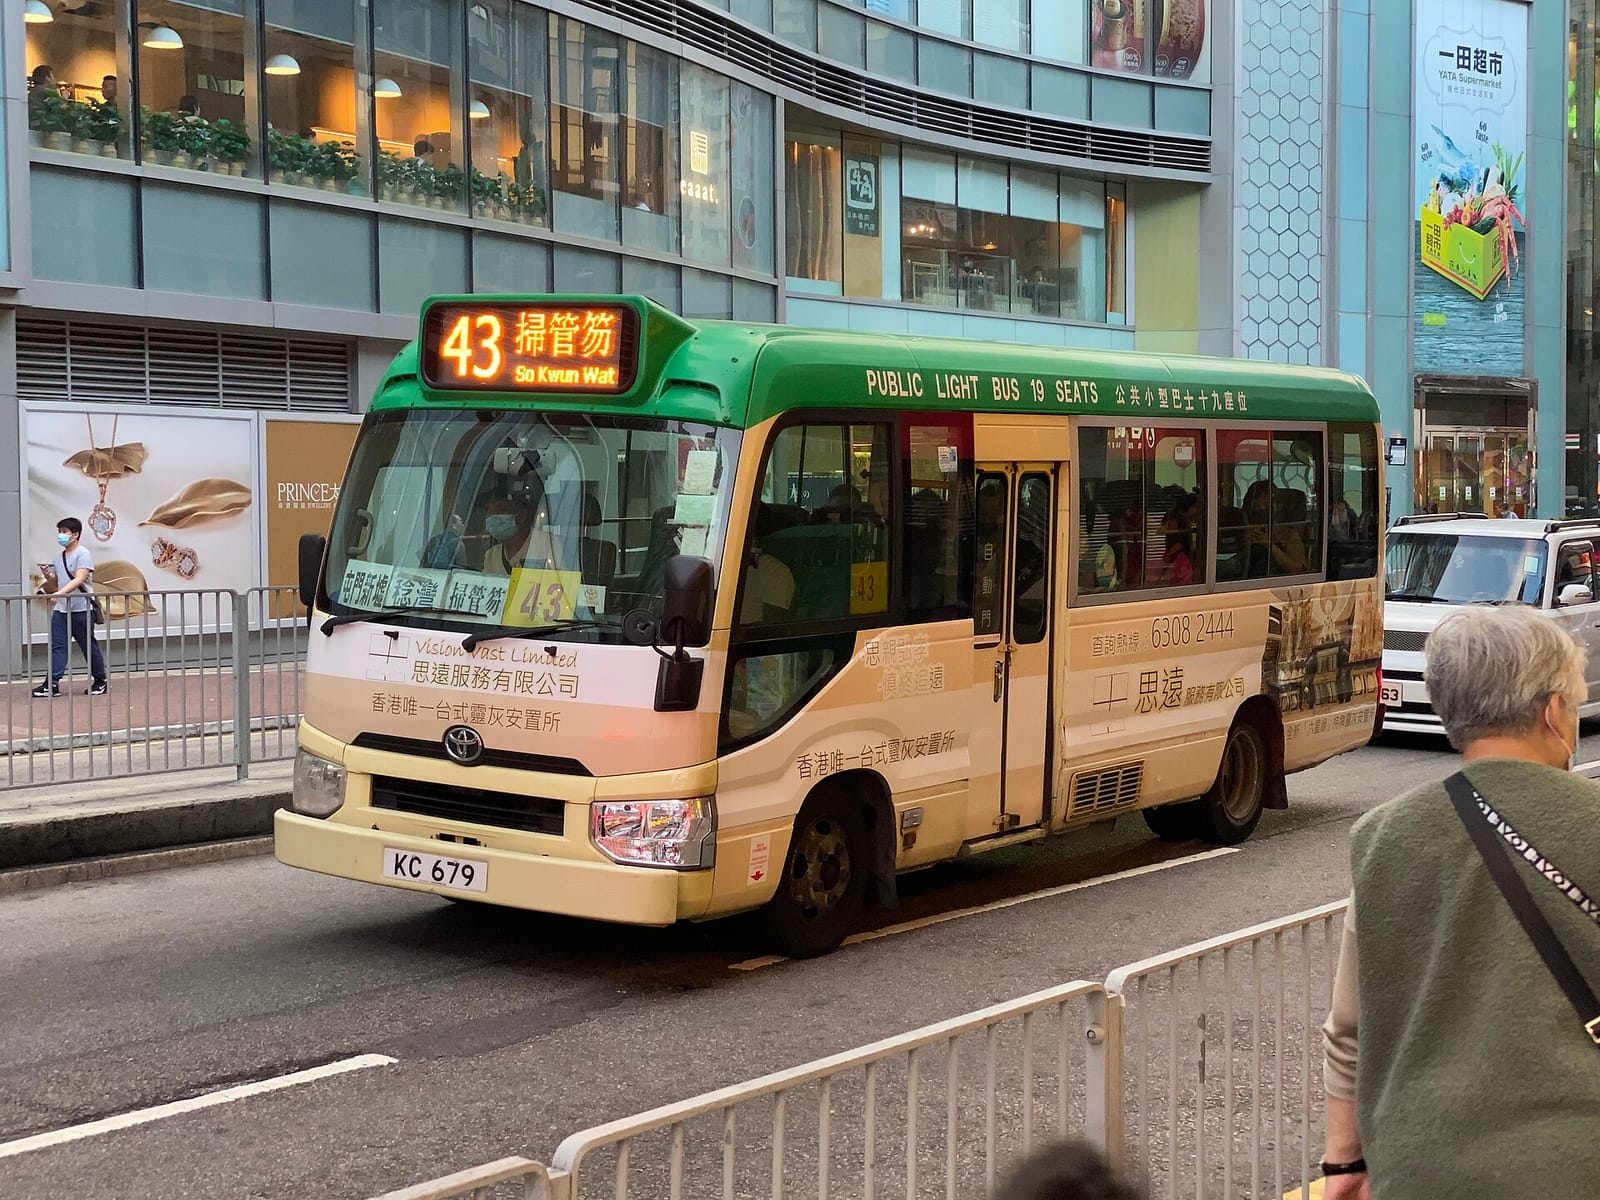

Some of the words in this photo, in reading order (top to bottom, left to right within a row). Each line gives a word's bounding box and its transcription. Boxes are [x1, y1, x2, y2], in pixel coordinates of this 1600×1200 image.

[1438, 45, 1503, 77] 一田超市
[1438, 69, 1457, 82] YATA
[1458, 73, 1502, 90] Supermarket
[1475, 130, 1489, 144] Taste
[441, 314, 501, 379] 43
[515, 311, 615, 357] 掃管笏
[515, 365, 535, 383] So
[537, 366, 579, 384] Kwun
[582, 366, 616, 385] Wat
[866, 369, 923, 397] PUBLIC
[935, 373, 979, 400] LIGHT
[991, 376, 1020, 401] BUS
[1030, 379, 1045, 402] 19
[1055, 379, 1098, 404] SEATS
[1115, 384, 1248, 412] 公共小型巴士十九座位
[277, 482, 330, 502] PRINCE
[450, 581, 506, 616] 掃管笏
[520, 582, 564, 623] 43
[857, 575, 874, 602] 43
[1151, 615, 1191, 649] 6308
[1196, 611, 1234, 643] 2444
[416, 638, 466, 657] Vision
[511, 646, 577, 668] Limited
[411, 660, 579, 699] 思遠服務有限公司
[1134, 666, 1184, 714] 思遠
[372, 692, 561, 734] 香港唯一台式靈灰安置所
[797, 729, 956, 780] 香港唯一台式靈灰安置所
[394, 853, 422, 878] KC
[431, 859, 475, 886] 679
